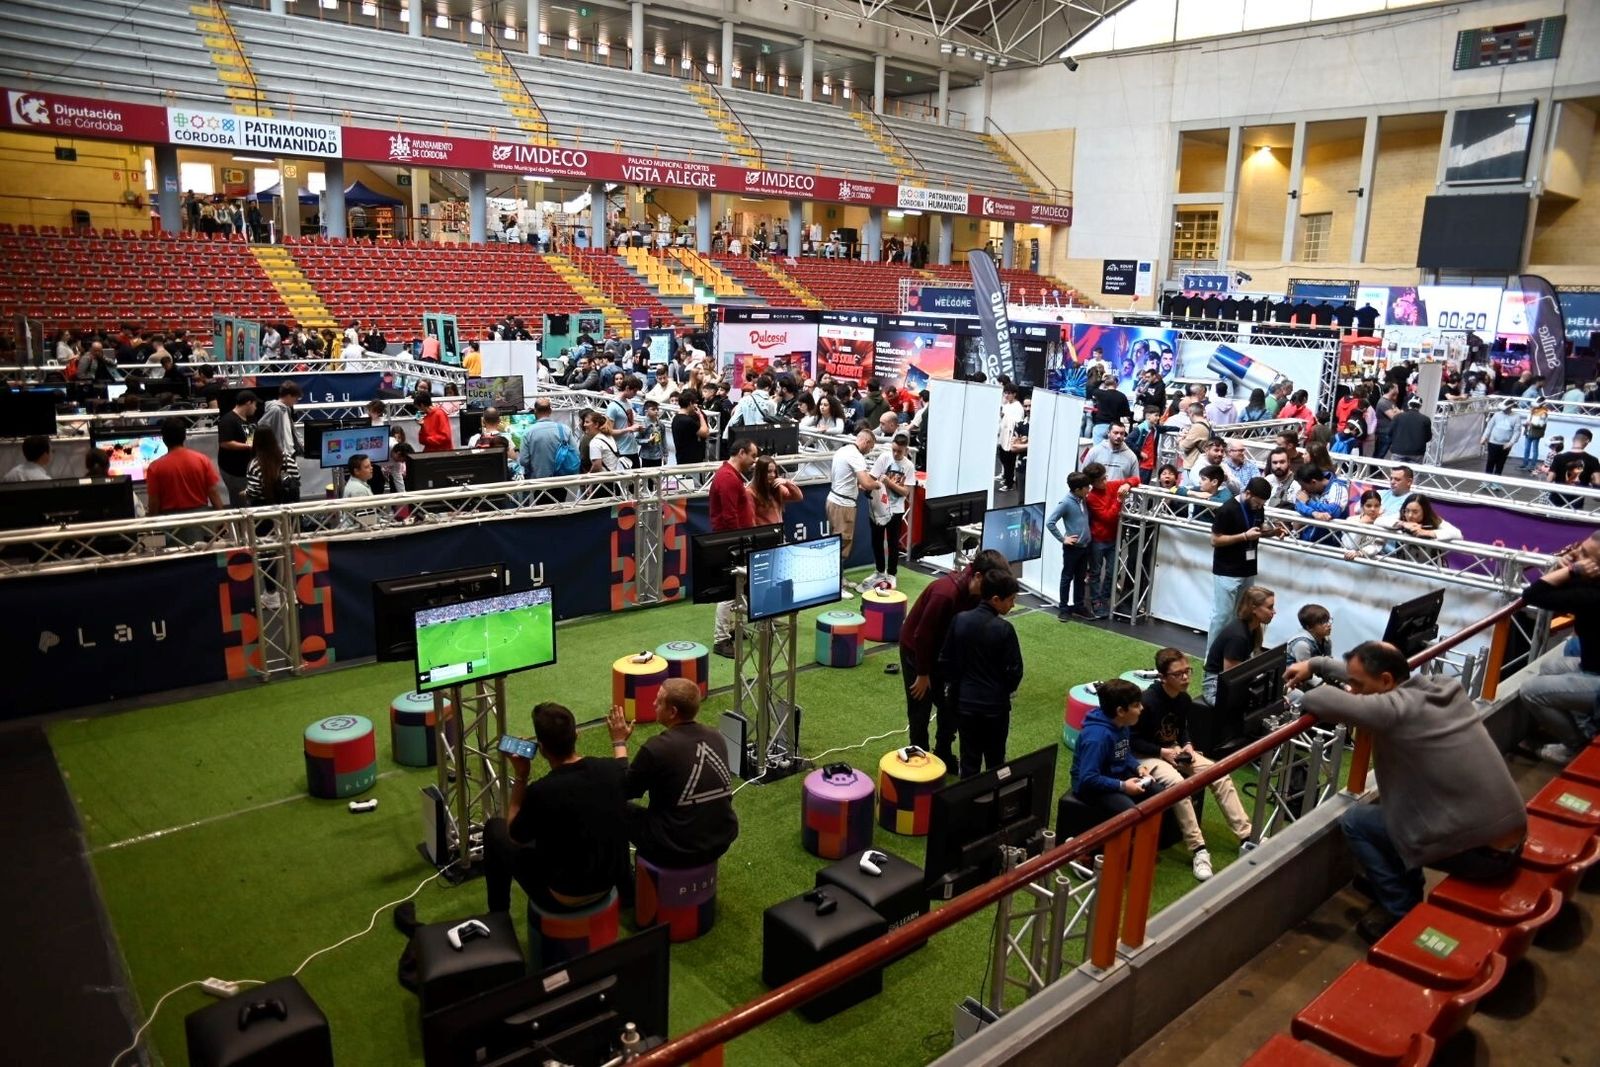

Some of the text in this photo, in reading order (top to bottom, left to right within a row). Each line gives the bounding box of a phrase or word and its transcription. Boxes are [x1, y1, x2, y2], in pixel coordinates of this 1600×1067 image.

[54, 104, 121, 121] Diputación
[56, 118, 123, 132] de Córdoba
[245, 121, 326, 139] PATRIMONIO
[175, 129, 235, 145] CÓRDOBA
[246, 134, 337, 154] HUMANIDAD
[412, 140, 453, 151] AYUNTAMIENTO
[412, 149, 420, 157] DE
[515, 146, 587, 168] IMDECO
[628, 157, 652, 165] PALACIO
[622, 165, 716, 187] VISTA ALEGRE
[762, 172, 814, 190] IMDECO
[928, 192, 962, 202] PATRIMONIO
[928, 202, 966, 211] HUMANIDAD
[1041, 205, 1069, 218] IMDECO
[935, 299, 971, 307] WELCOME
[1438, 311, 1487, 330] 00:20
[750, 330, 787, 344] Dulcesol
